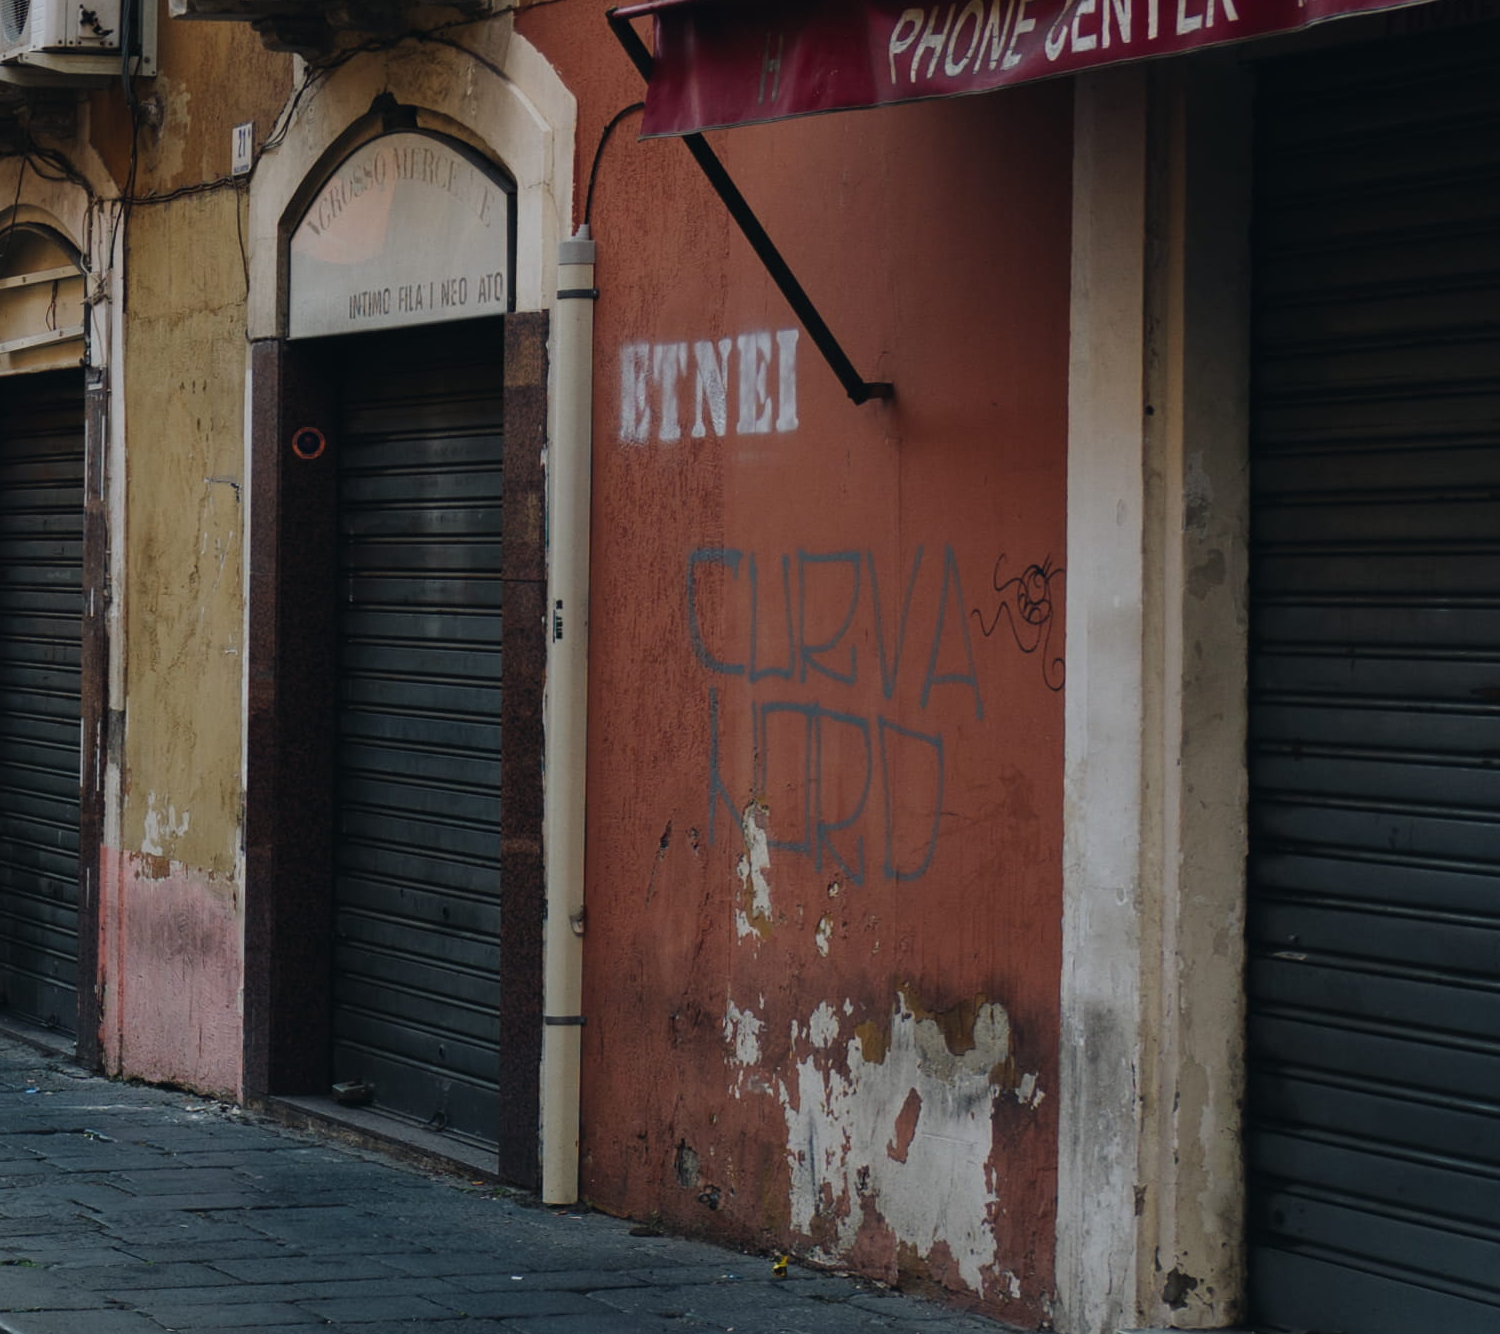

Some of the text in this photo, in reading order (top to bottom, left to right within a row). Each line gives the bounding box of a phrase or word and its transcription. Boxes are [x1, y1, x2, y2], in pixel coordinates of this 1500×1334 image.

[618, 328, 799, 446] ETNEI
[686, 543, 984, 720] CURVA
[708, 686, 945, 887] NORD
